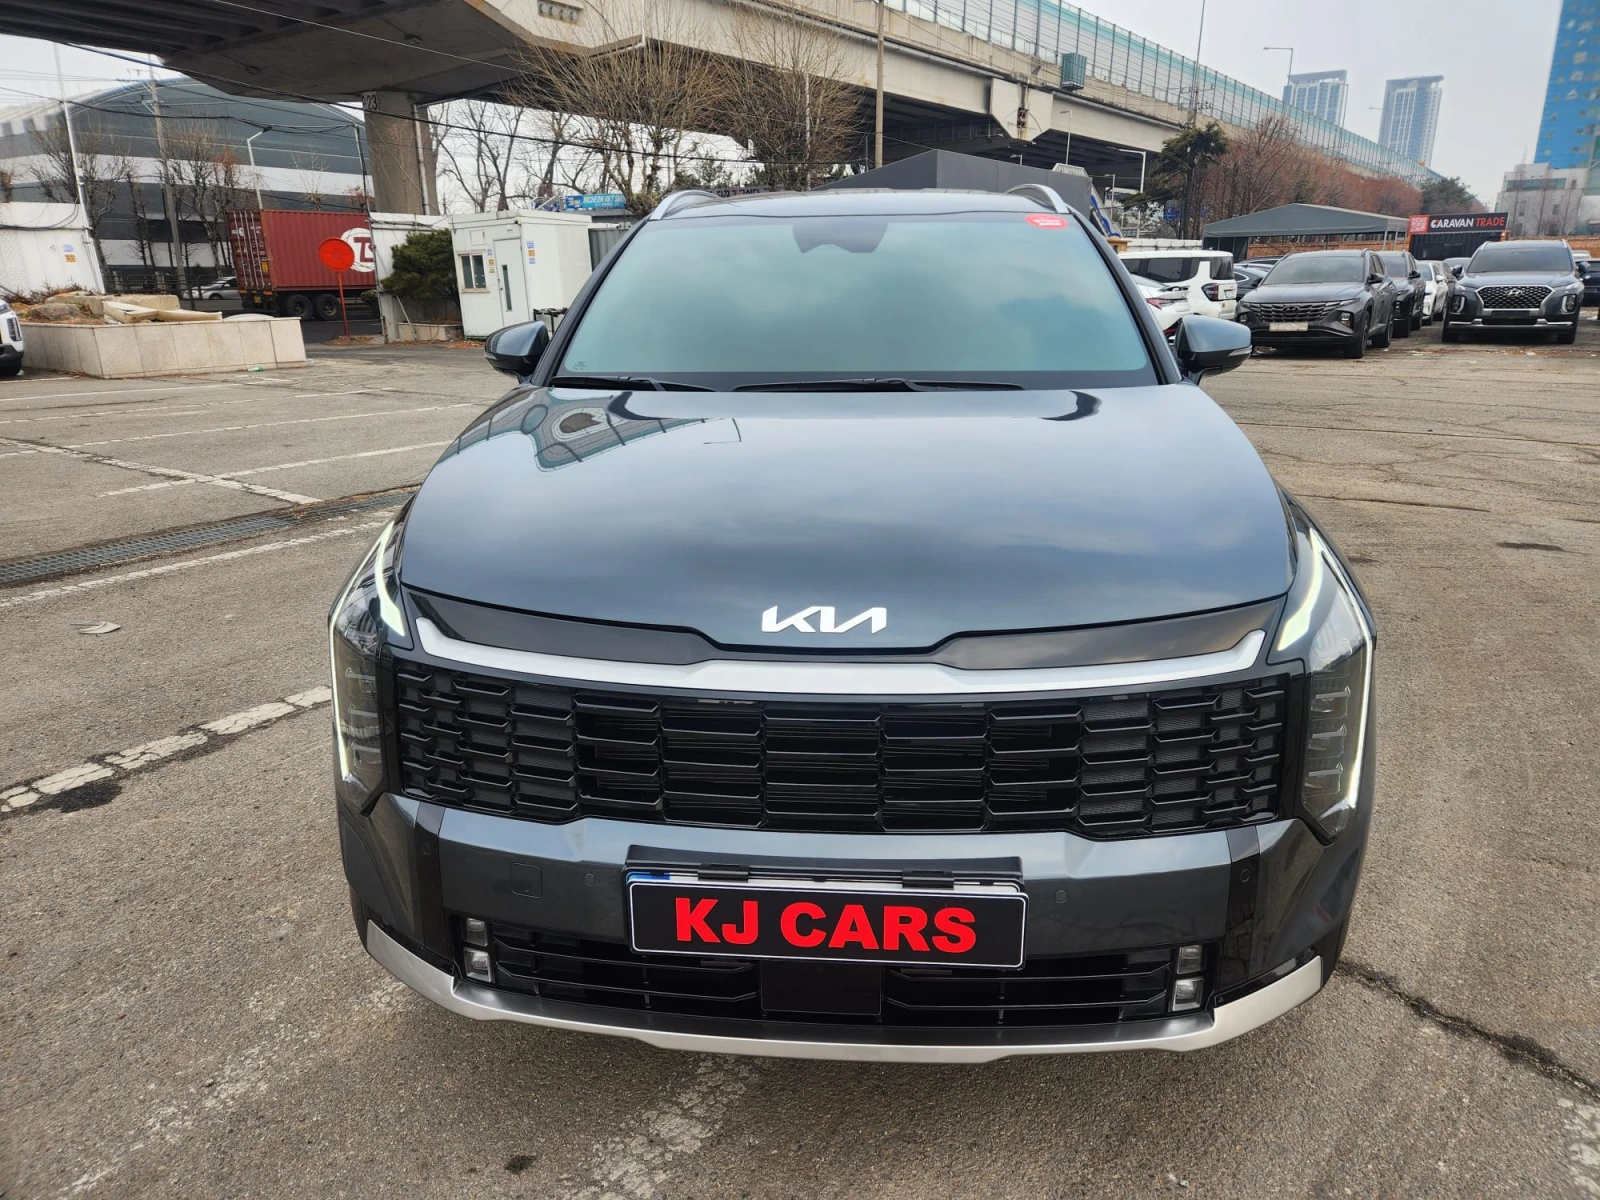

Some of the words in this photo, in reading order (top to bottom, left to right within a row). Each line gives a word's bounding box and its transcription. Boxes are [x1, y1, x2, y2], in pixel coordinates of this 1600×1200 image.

[1430, 218, 1474, 228] CARAVAN
[1476, 216, 1505, 227] TRADE
[762, 605, 887, 634] KIA
[675, 897, 759, 944] KJ
[780, 902, 977, 953] CARS
